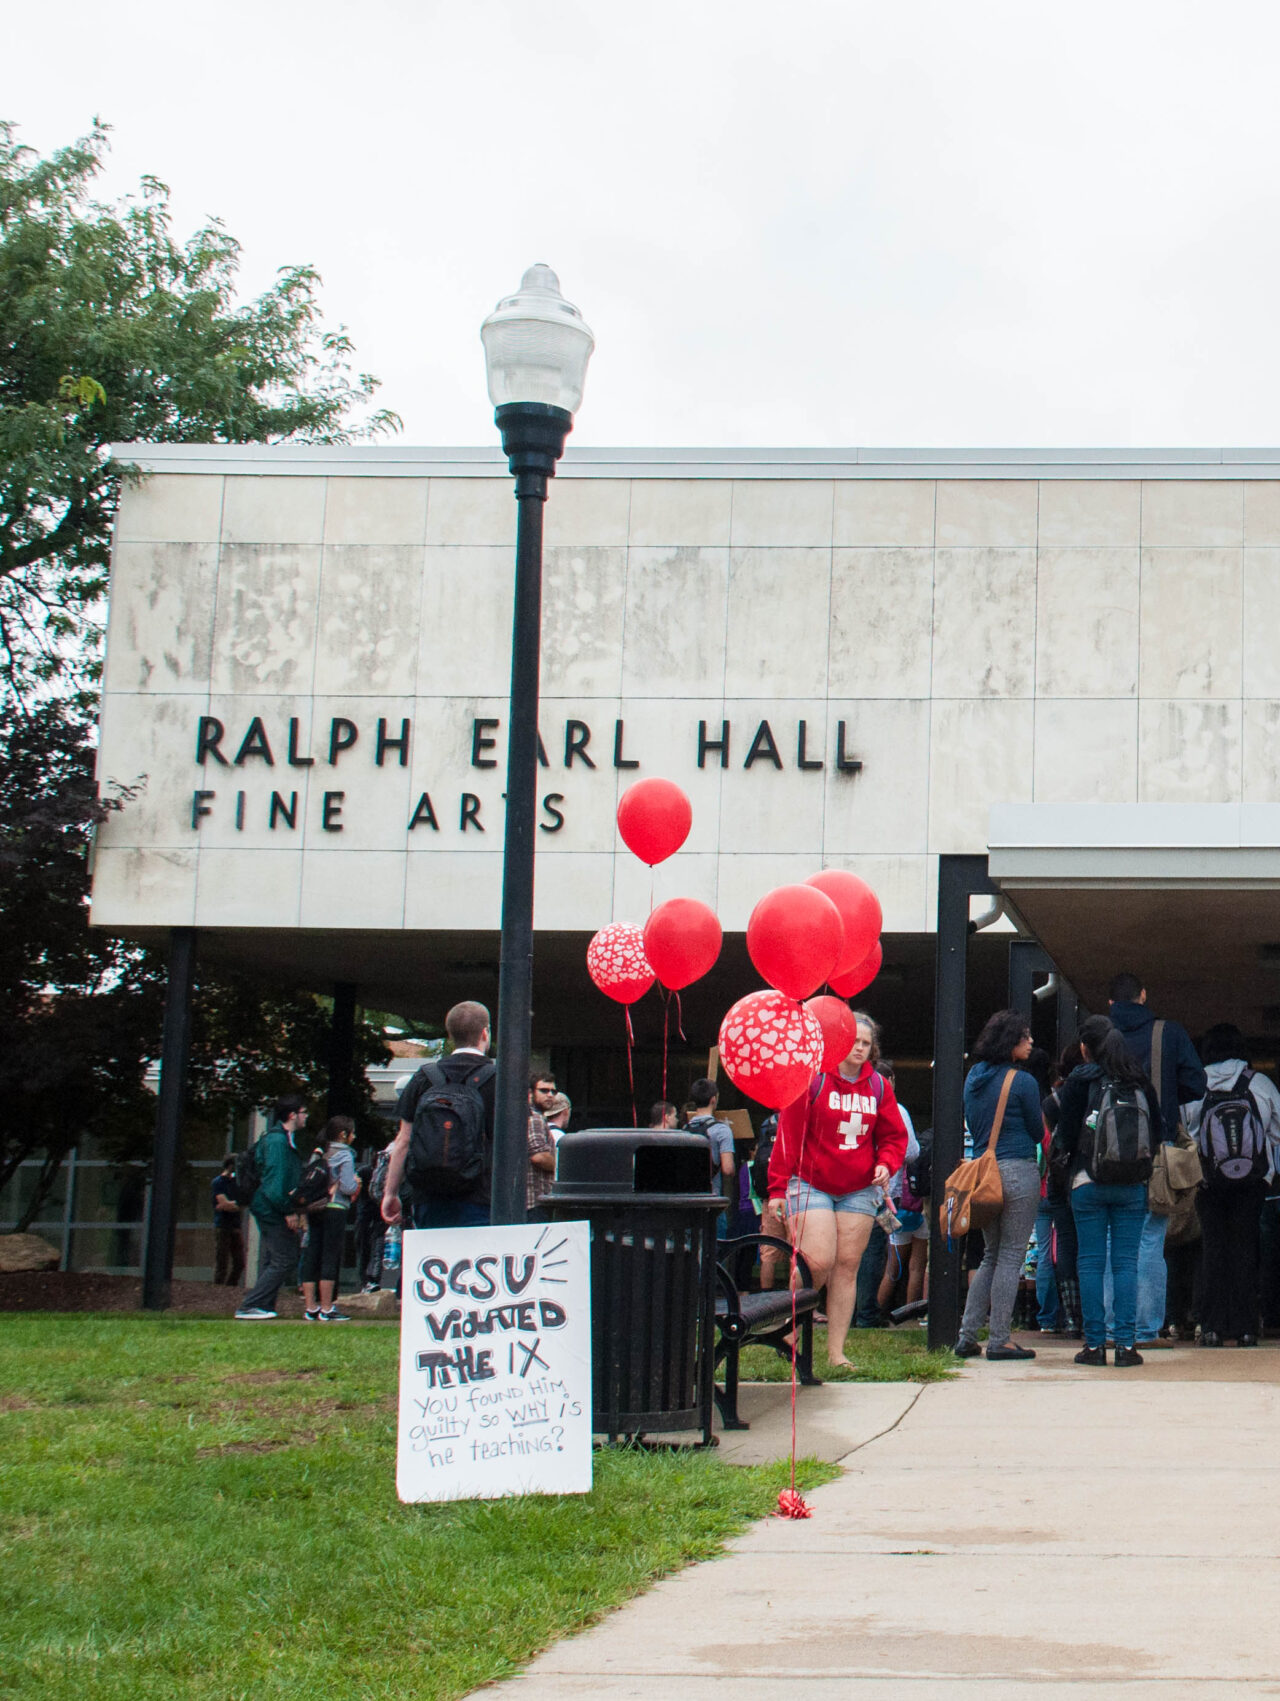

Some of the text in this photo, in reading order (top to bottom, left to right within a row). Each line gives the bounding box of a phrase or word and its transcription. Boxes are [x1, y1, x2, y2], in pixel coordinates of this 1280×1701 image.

[196, 716, 411, 768] RALPH
[697, 719, 863, 770] HALL
[191, 790, 565, 833] FINE ARS
[829, 1091, 877, 1115] GUARD
[415, 1254, 537, 1303] SCSU
[508, 1338, 551, 1378] IX
[409, 1416, 470, 1452] guilty
[505, 1398, 549, 1424] WHY
[414, 1396, 458, 1418] YOU
[429, 1447, 455, 1468] he
